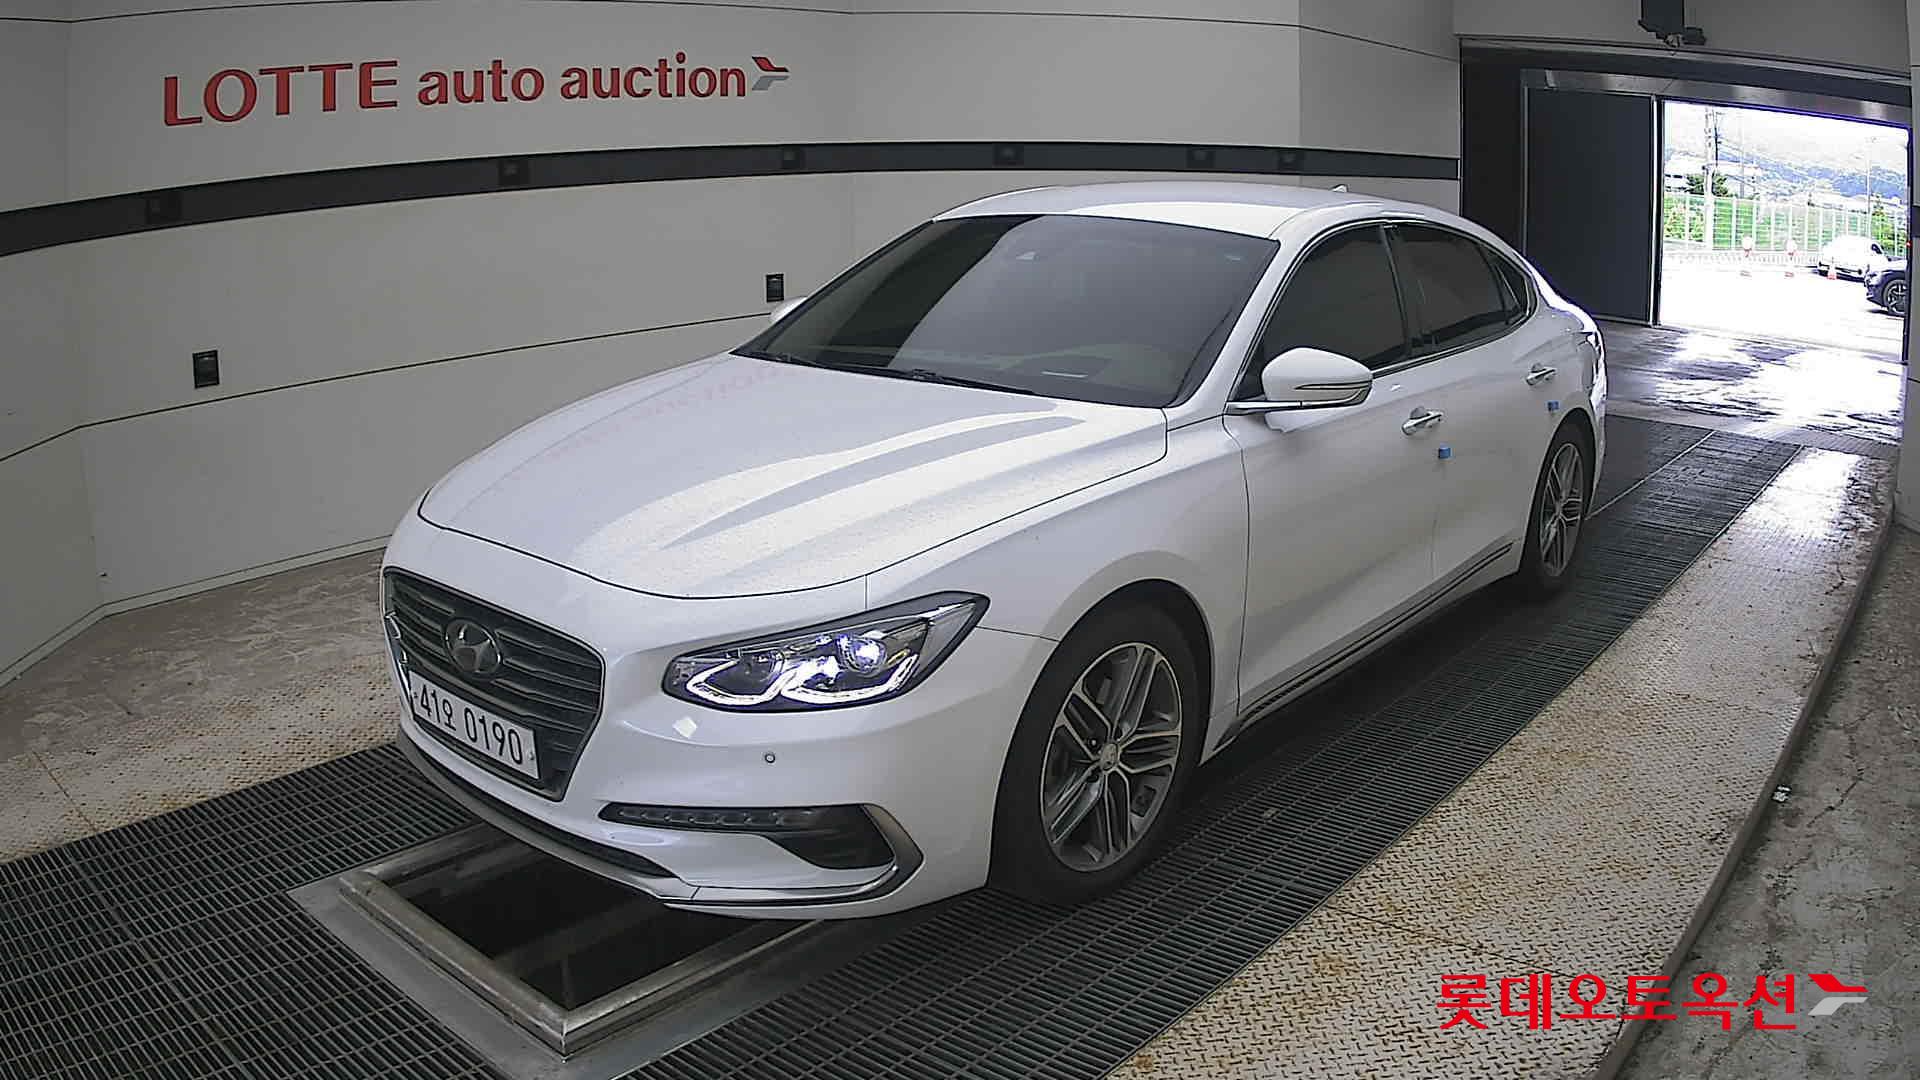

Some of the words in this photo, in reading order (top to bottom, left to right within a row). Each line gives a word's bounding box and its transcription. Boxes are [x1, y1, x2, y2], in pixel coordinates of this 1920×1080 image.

[164, 60, 398, 126] LOTTE
[418, 59, 544, 105] auto
[560, 51, 747, 98] auction
[420, 684, 457, 731] 41오
[464, 707, 523, 765] 0190
